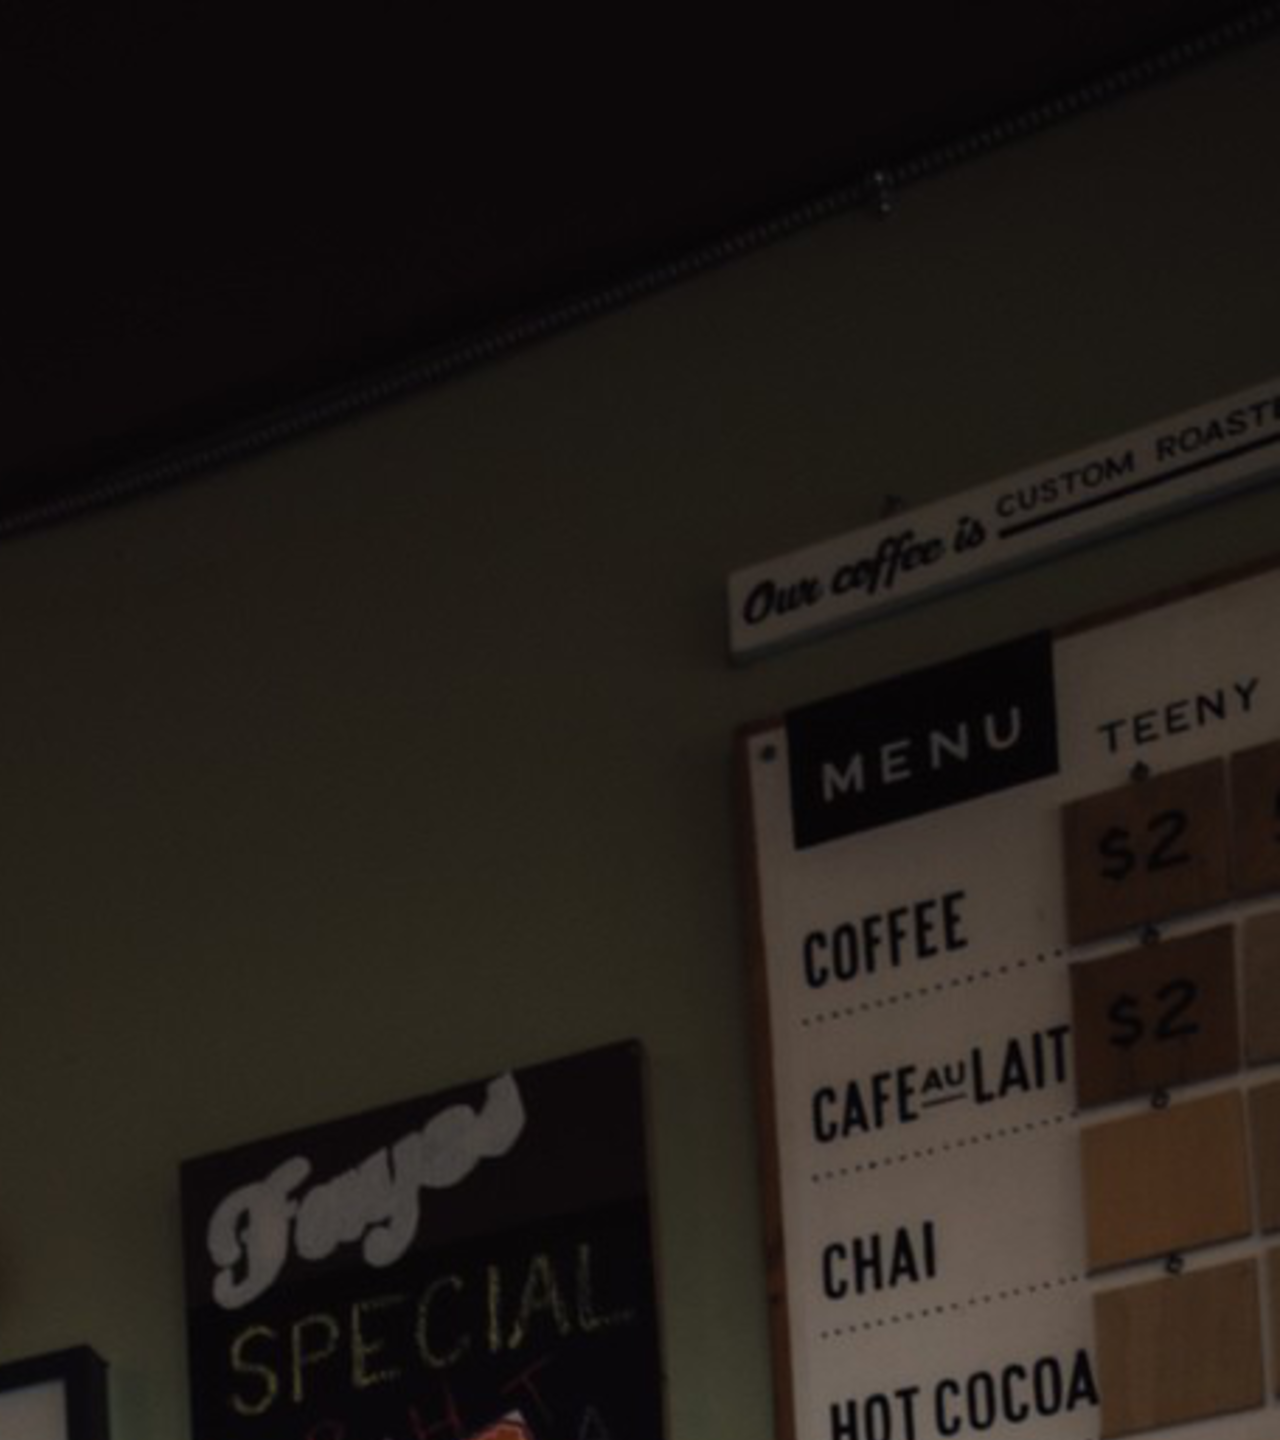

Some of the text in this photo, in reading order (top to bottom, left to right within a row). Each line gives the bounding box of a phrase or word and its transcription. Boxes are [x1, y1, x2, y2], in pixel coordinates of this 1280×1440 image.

[743, 580, 821, 625] Our
[831, 531, 942, 593] coffee
[954, 517, 986, 553] is
[996, 452, 1135, 518] CUSTOM
[822, 678, 1260, 802] MENU TEENY
[804, 810, 1190, 988] COFFEE $2
[814, 980, 1199, 1142] CAFE AU LAIT $2
[229, 1243, 635, 1417] SPECIAL
[823, 1222, 936, 1299] CHAI
[936, 1350, 1099, 1436] COCOA
